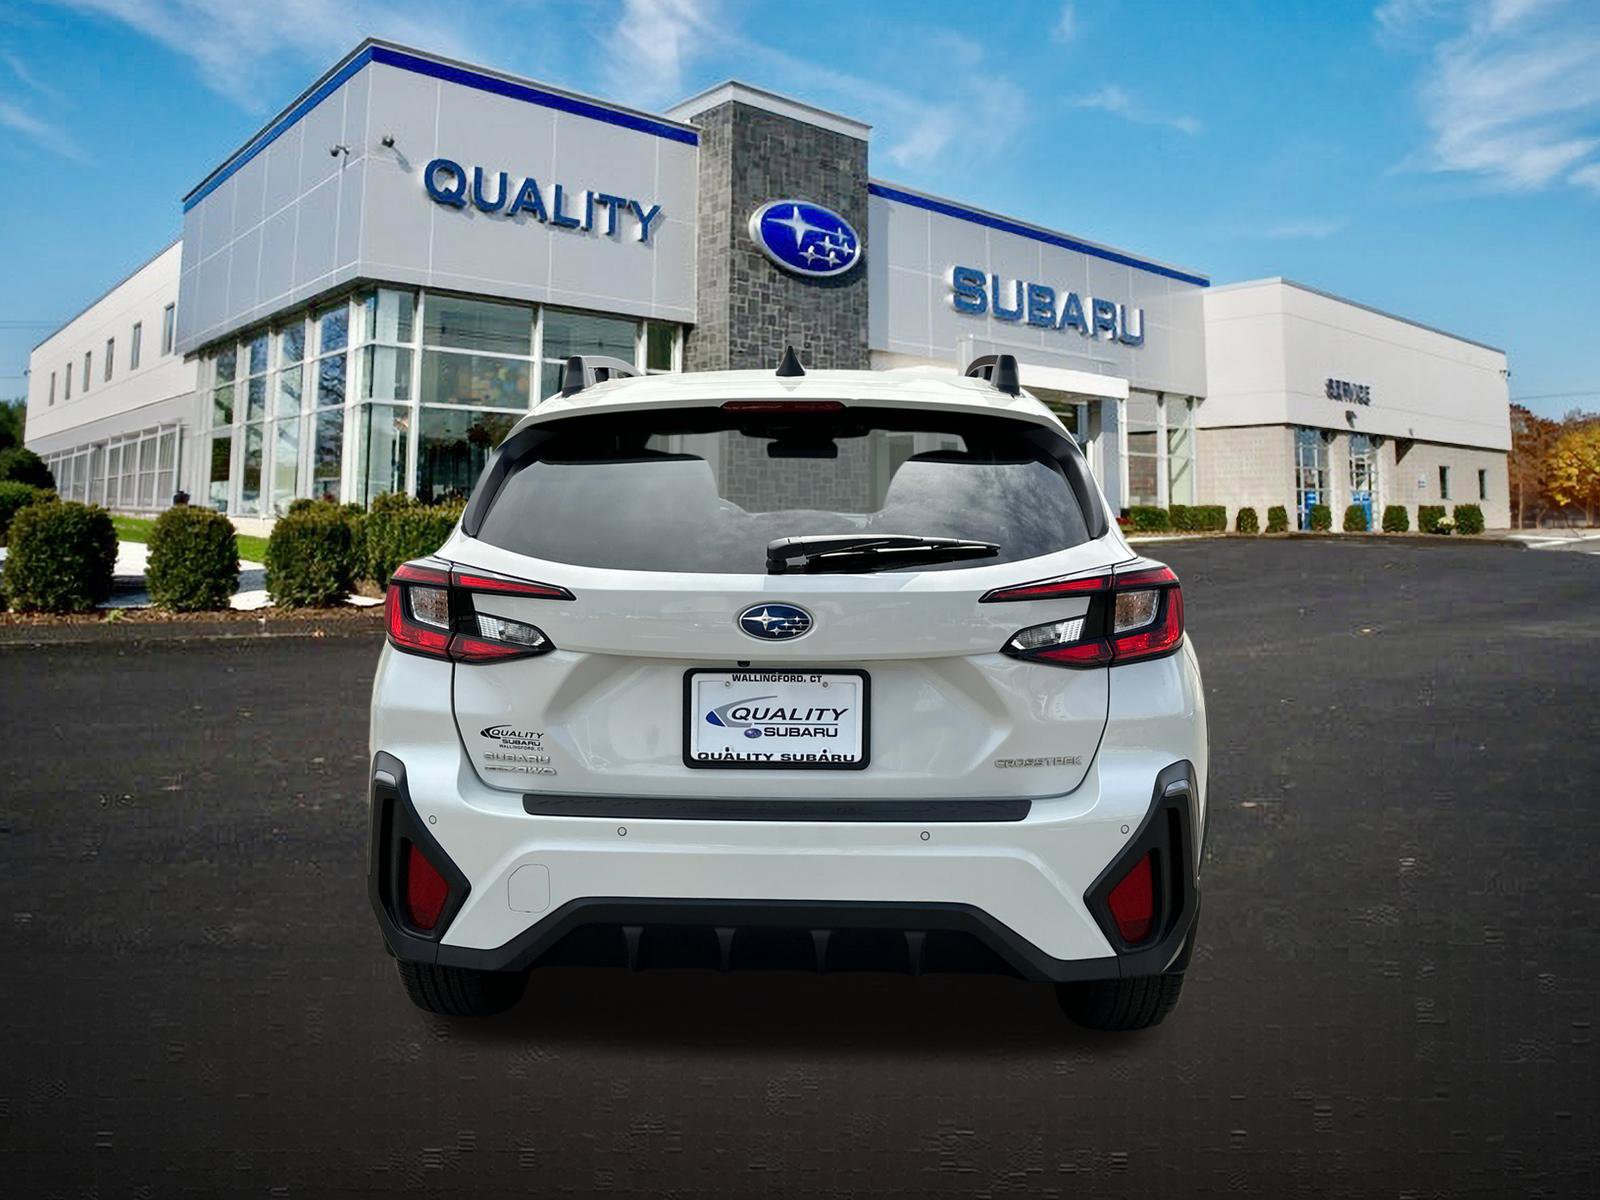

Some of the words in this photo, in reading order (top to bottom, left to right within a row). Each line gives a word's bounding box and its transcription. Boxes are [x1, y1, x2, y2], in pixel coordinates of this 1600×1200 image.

[424, 158, 662, 242] QUALITY
[950, 265, 1145, 346] SUBARU
[810, 675, 823, 683] CT
[731, 707, 849, 721] QUALITY
[491, 729, 544, 739] QUALITY
[763, 727, 838, 738] SUBARU
[484, 752, 551, 764] SUBARU
[697, 752, 773, 762] QUALITY
[780, 753, 855, 763] SUBARU
[994, 756, 1082, 768] CROSSTREK
